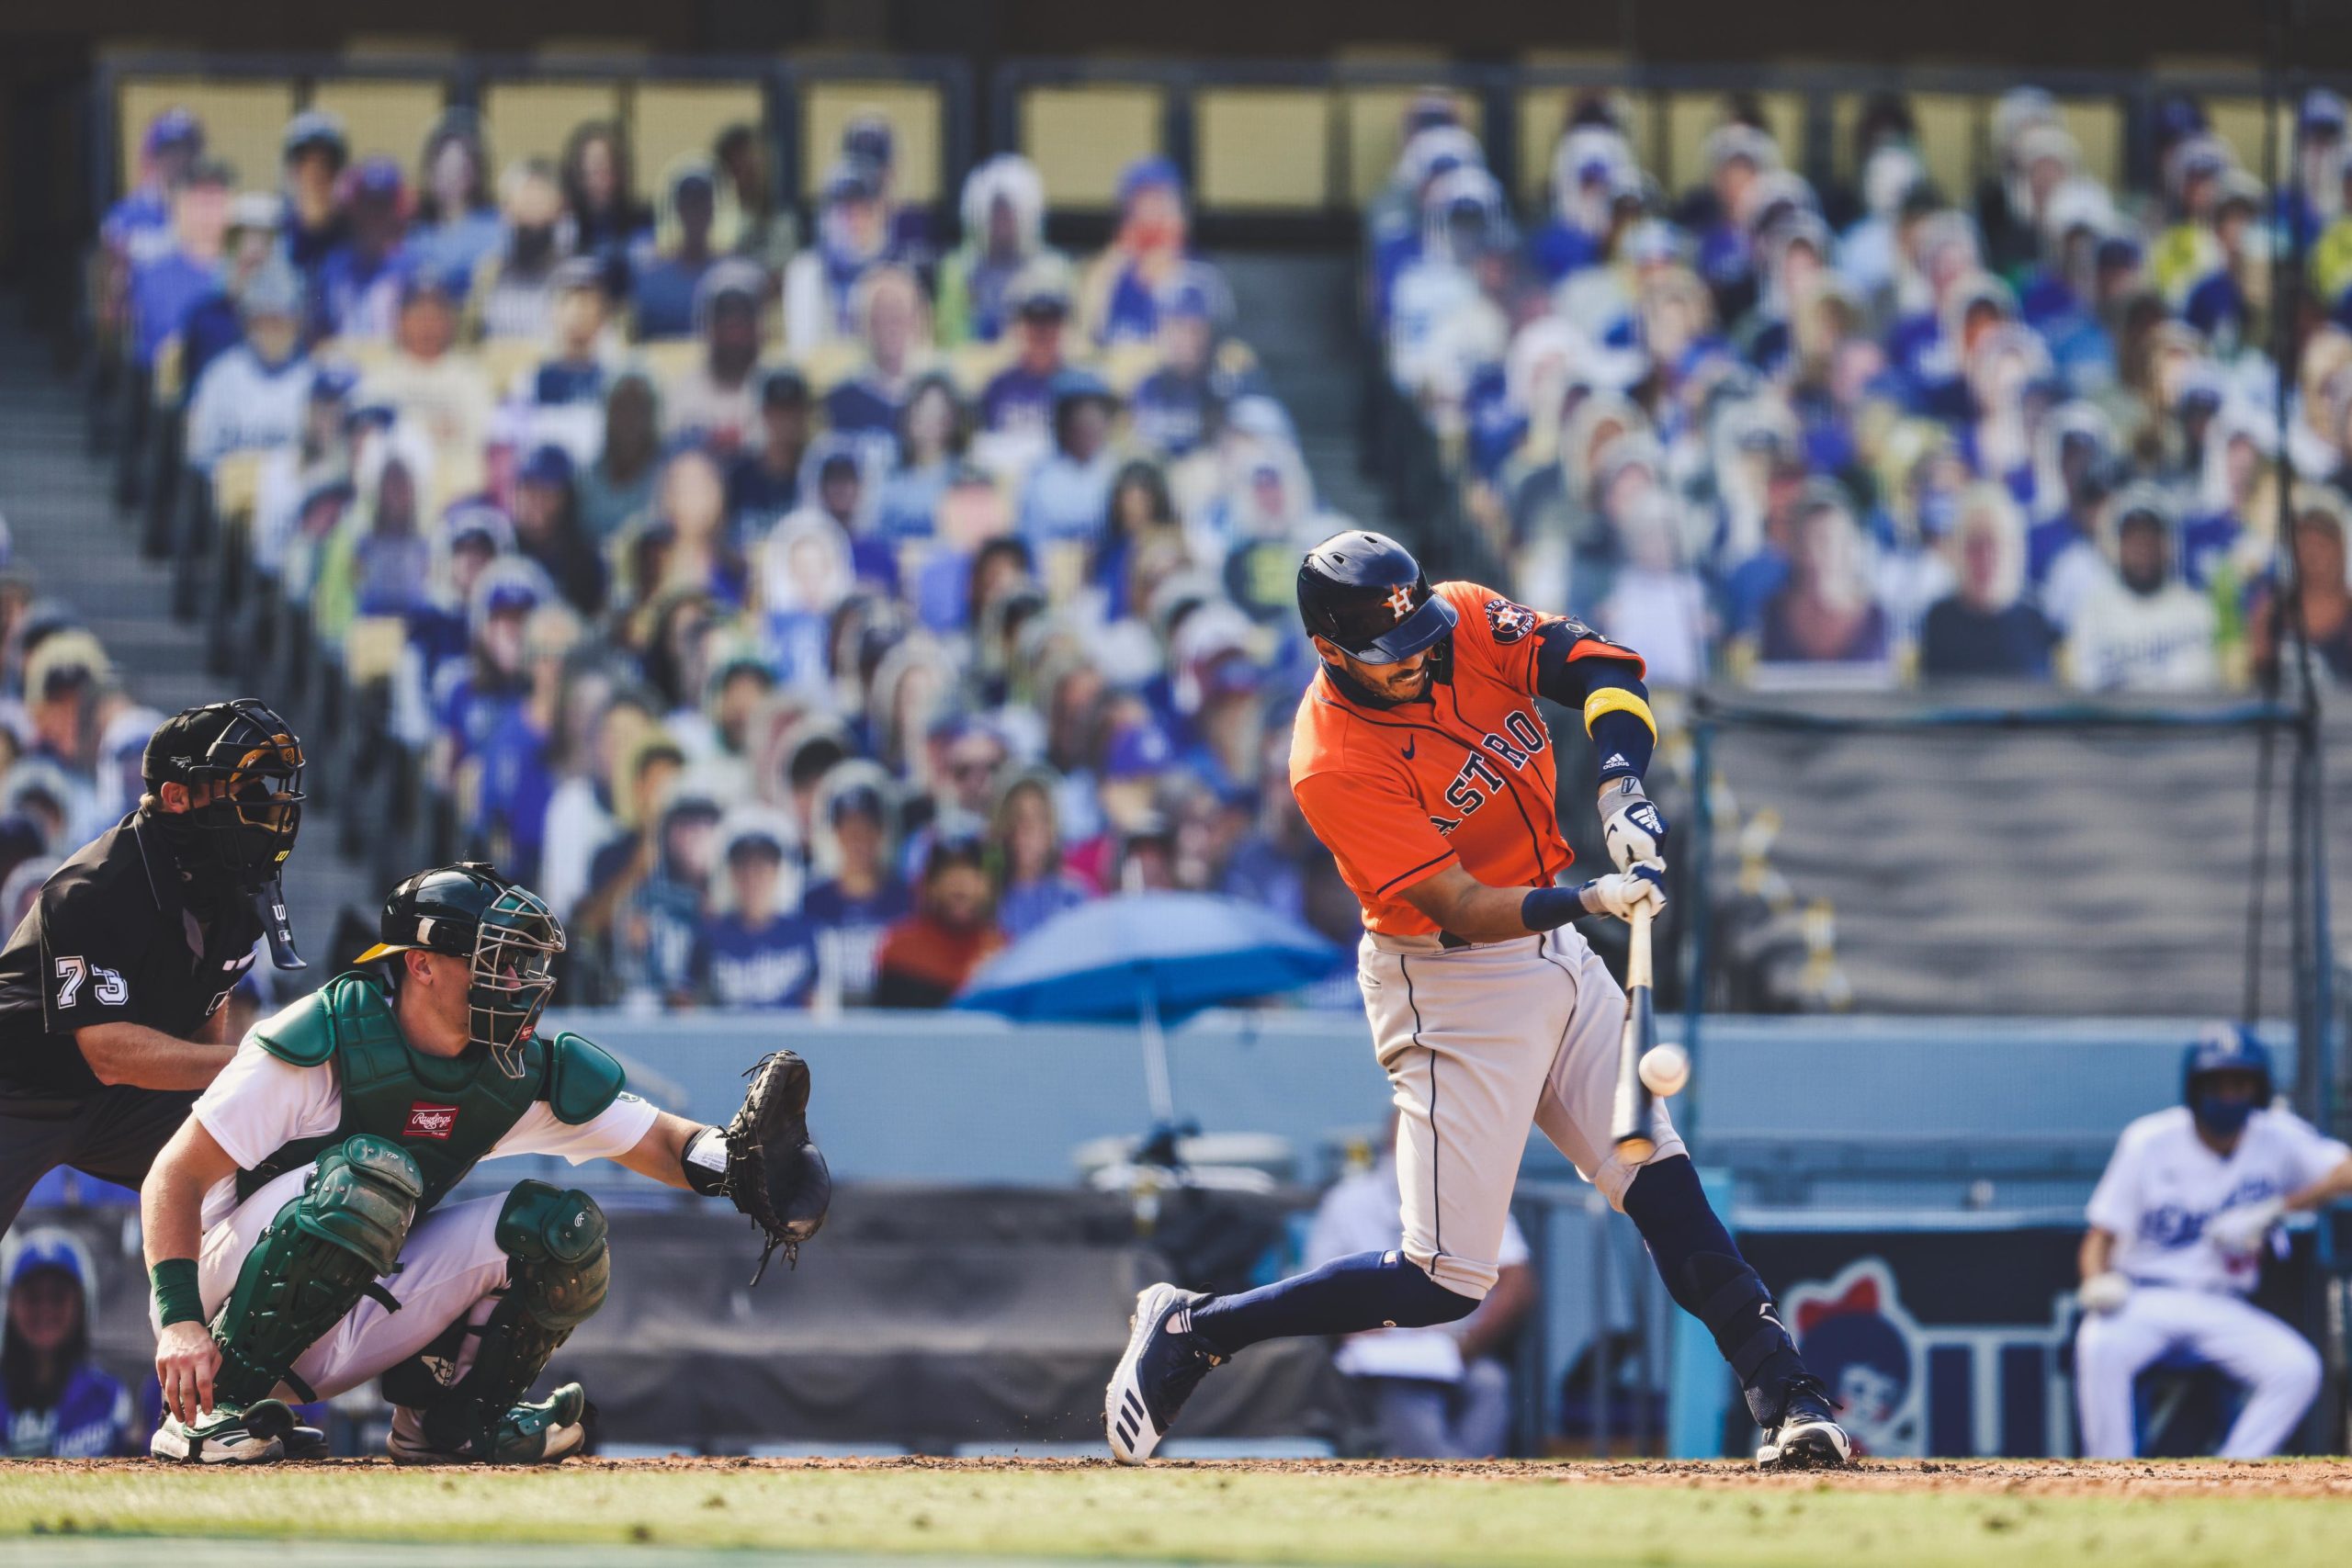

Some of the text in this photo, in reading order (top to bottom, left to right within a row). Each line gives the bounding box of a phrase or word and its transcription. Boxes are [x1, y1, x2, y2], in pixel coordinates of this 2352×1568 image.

[1387, 587, 1414, 619] H
[1430, 698, 1553, 837] ASTRO
[55, 955, 129, 1009] 73
[412, 1111, 452, 1130] Rawlings
